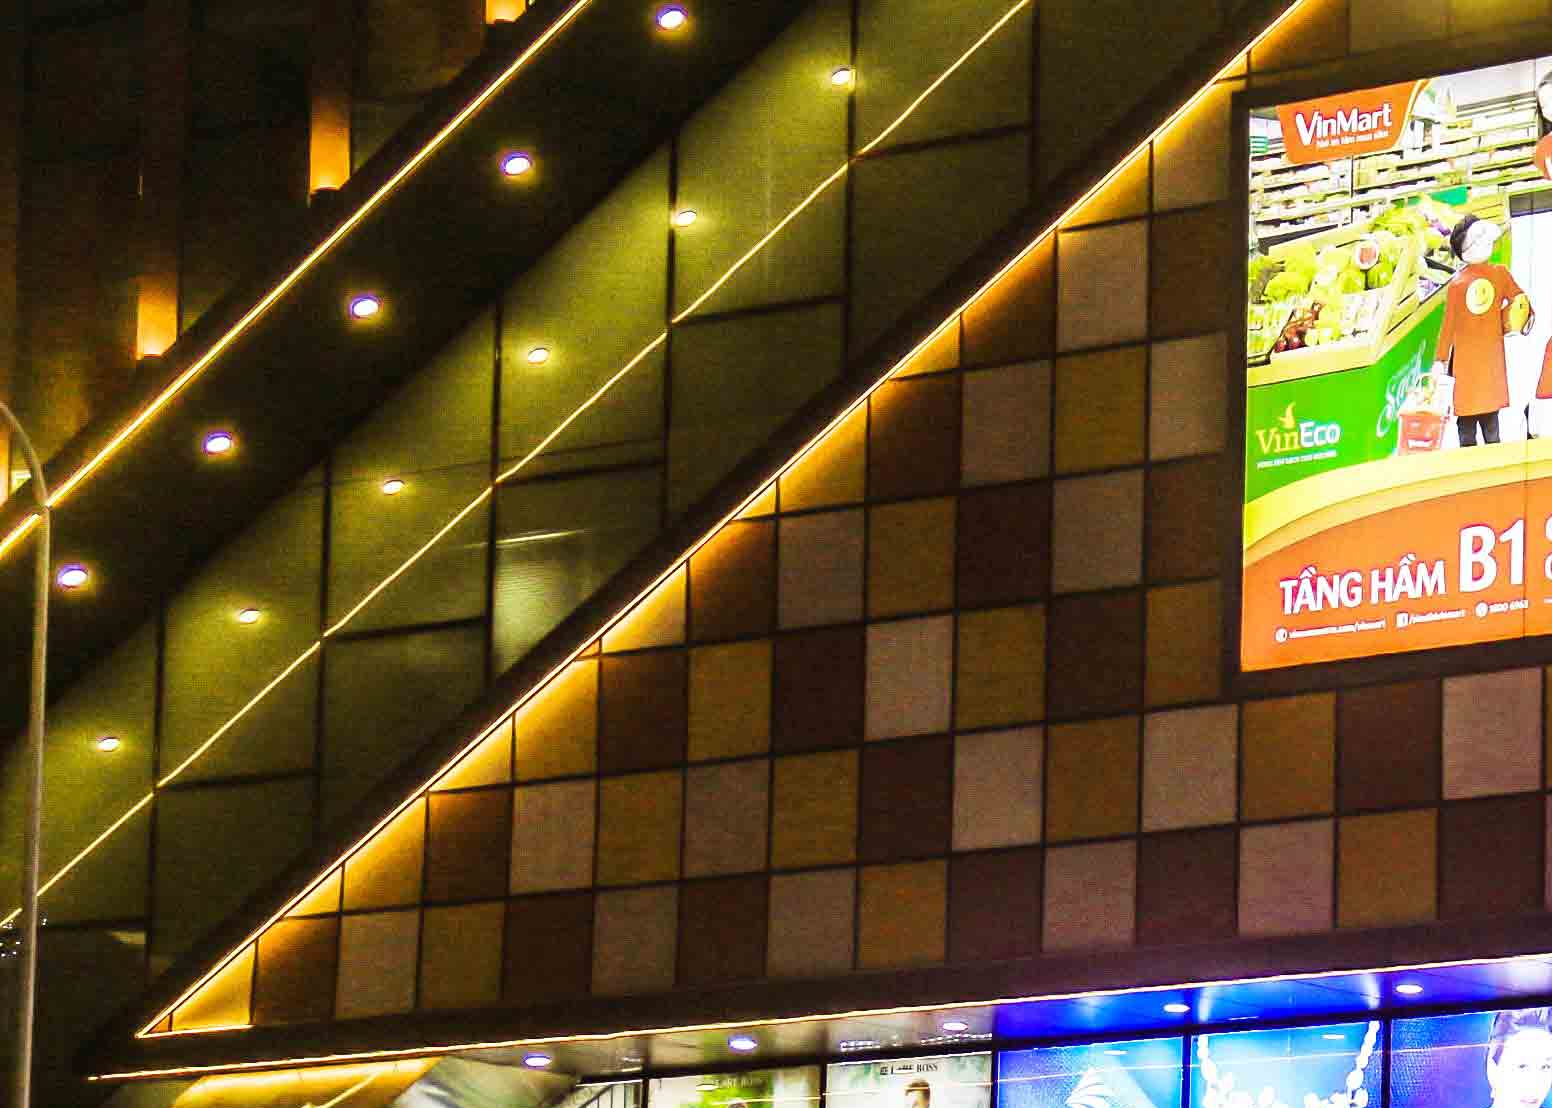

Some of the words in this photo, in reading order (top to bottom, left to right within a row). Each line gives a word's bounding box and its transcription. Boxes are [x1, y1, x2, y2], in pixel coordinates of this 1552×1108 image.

[1295, 103, 1392, 146] VinMart
[1256, 420, 1341, 454] VinEco
[1279, 565, 1363, 615] TẦNG
[1370, 553, 1446, 604] HẦM
[1459, 519, 1524, 593] B1
